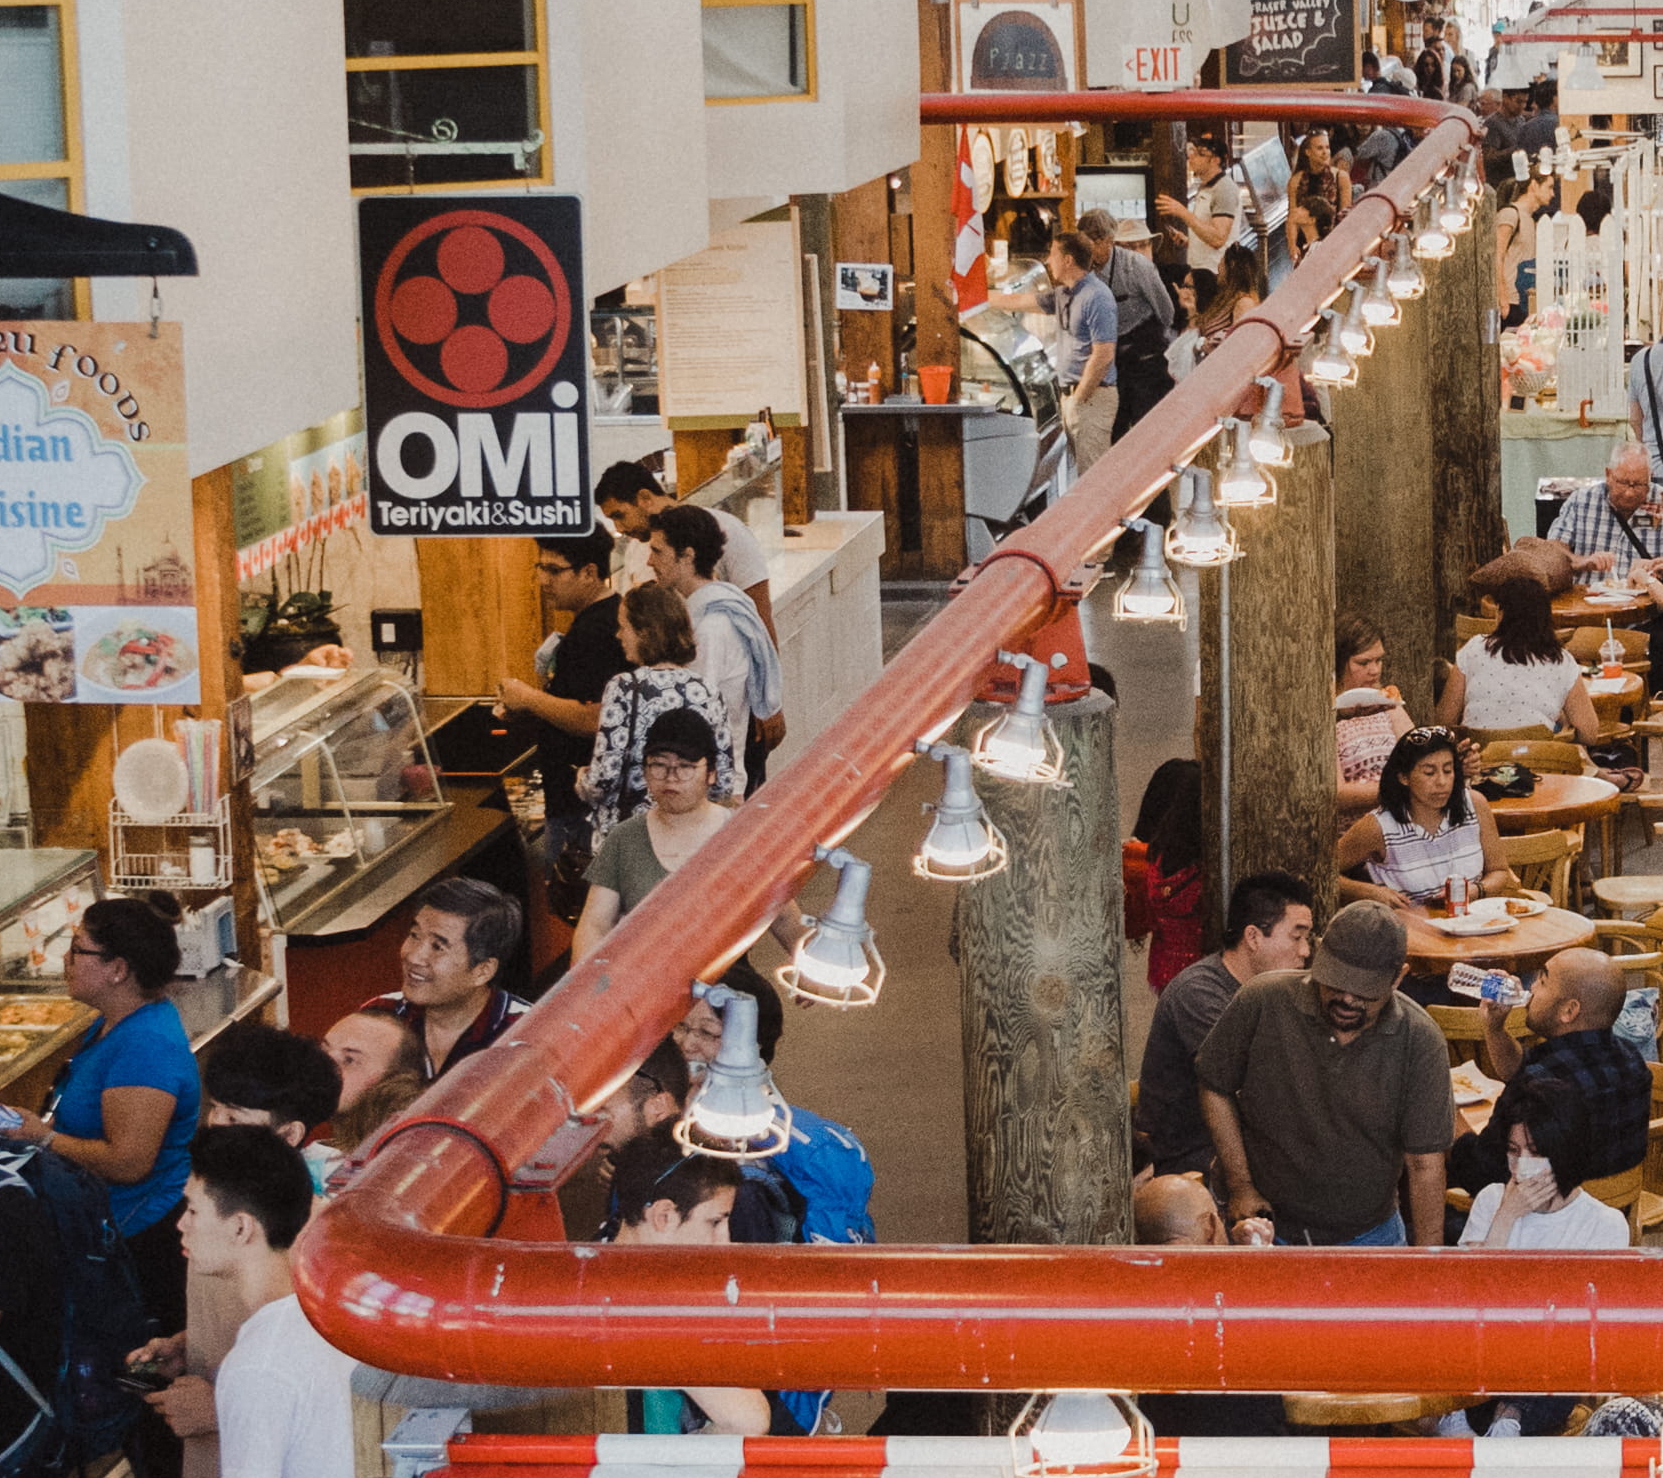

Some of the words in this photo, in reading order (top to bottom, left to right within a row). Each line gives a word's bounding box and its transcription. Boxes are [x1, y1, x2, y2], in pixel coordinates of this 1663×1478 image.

[1251, 11, 1308, 34] JUICE
[1252, 31, 1303, 56] SALAD
[1137, 47, 1181, 82] EXIT
